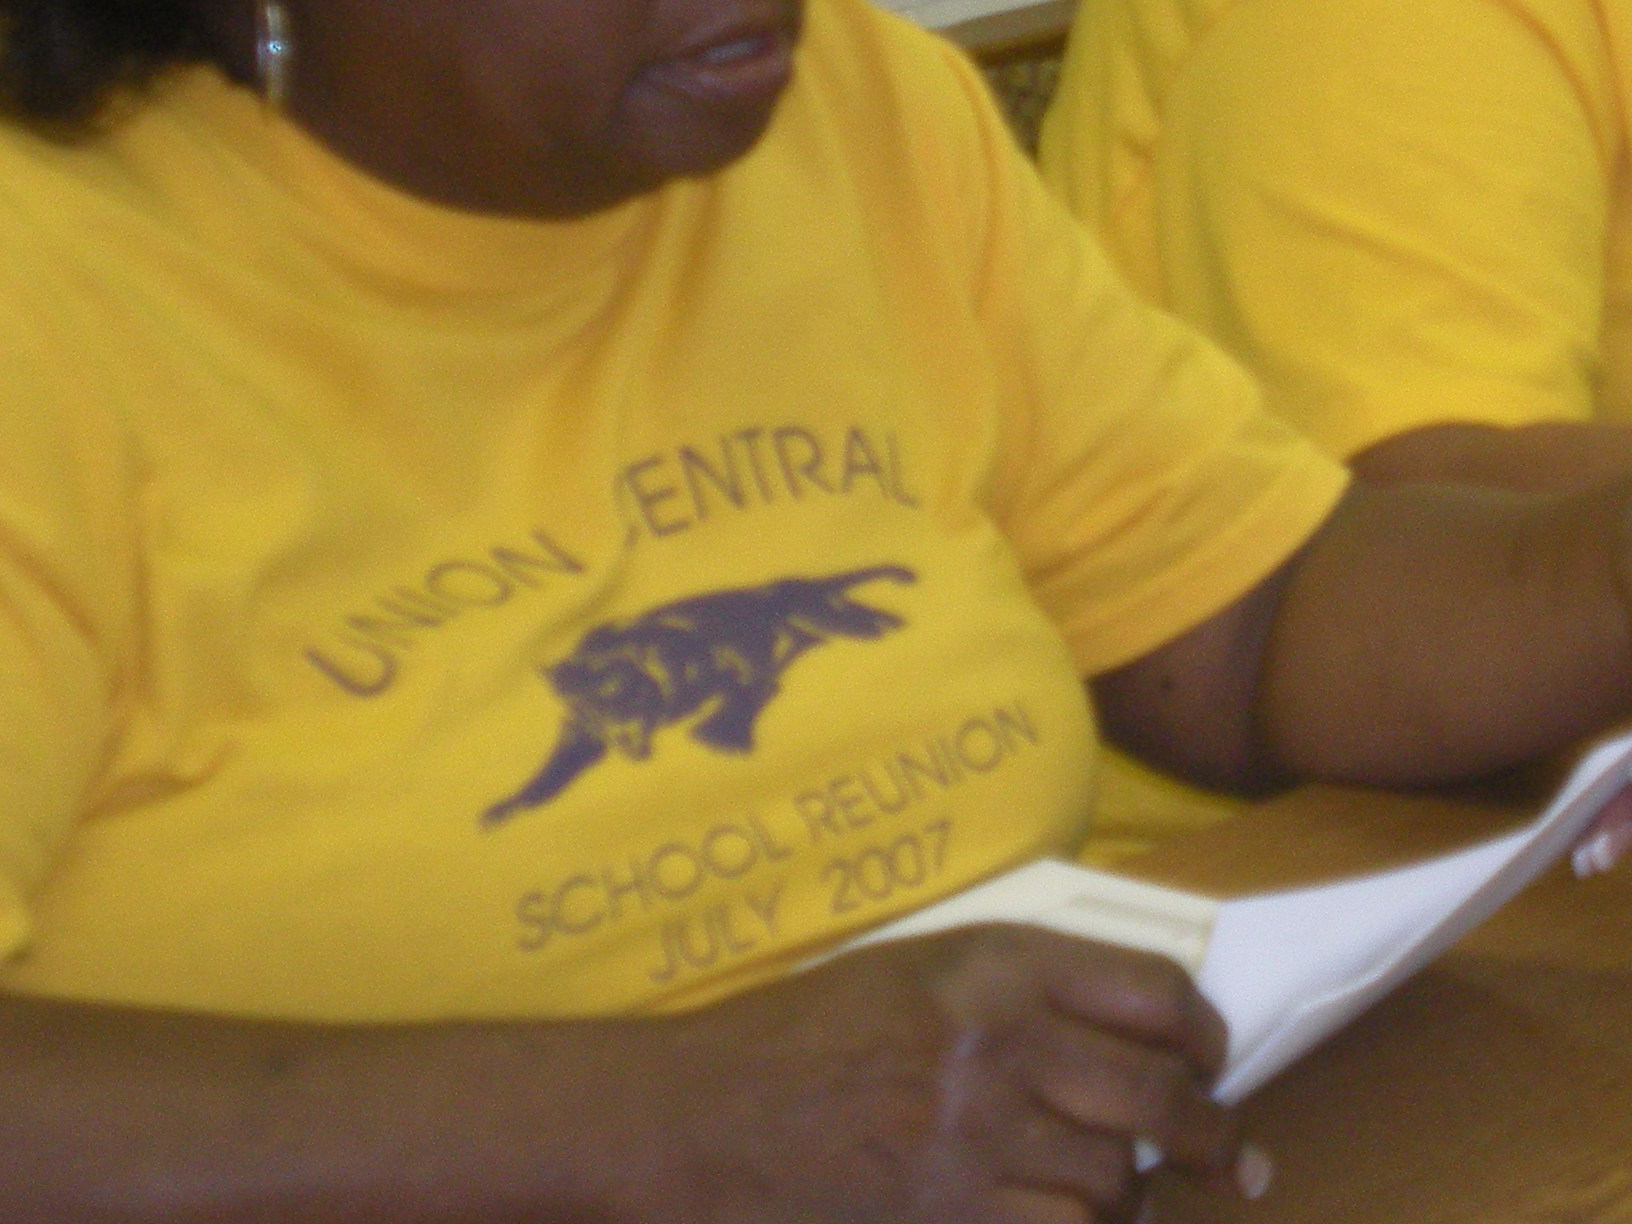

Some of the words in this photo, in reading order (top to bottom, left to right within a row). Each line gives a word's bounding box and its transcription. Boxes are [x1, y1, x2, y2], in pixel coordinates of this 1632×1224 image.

[304, 524, 588, 699] UNION
[514, 812, 792, 954] SCHOOL
[793, 699, 1040, 846] REUNION
[648, 882, 792, 983] JULY
[824, 818, 954, 913] 2007
